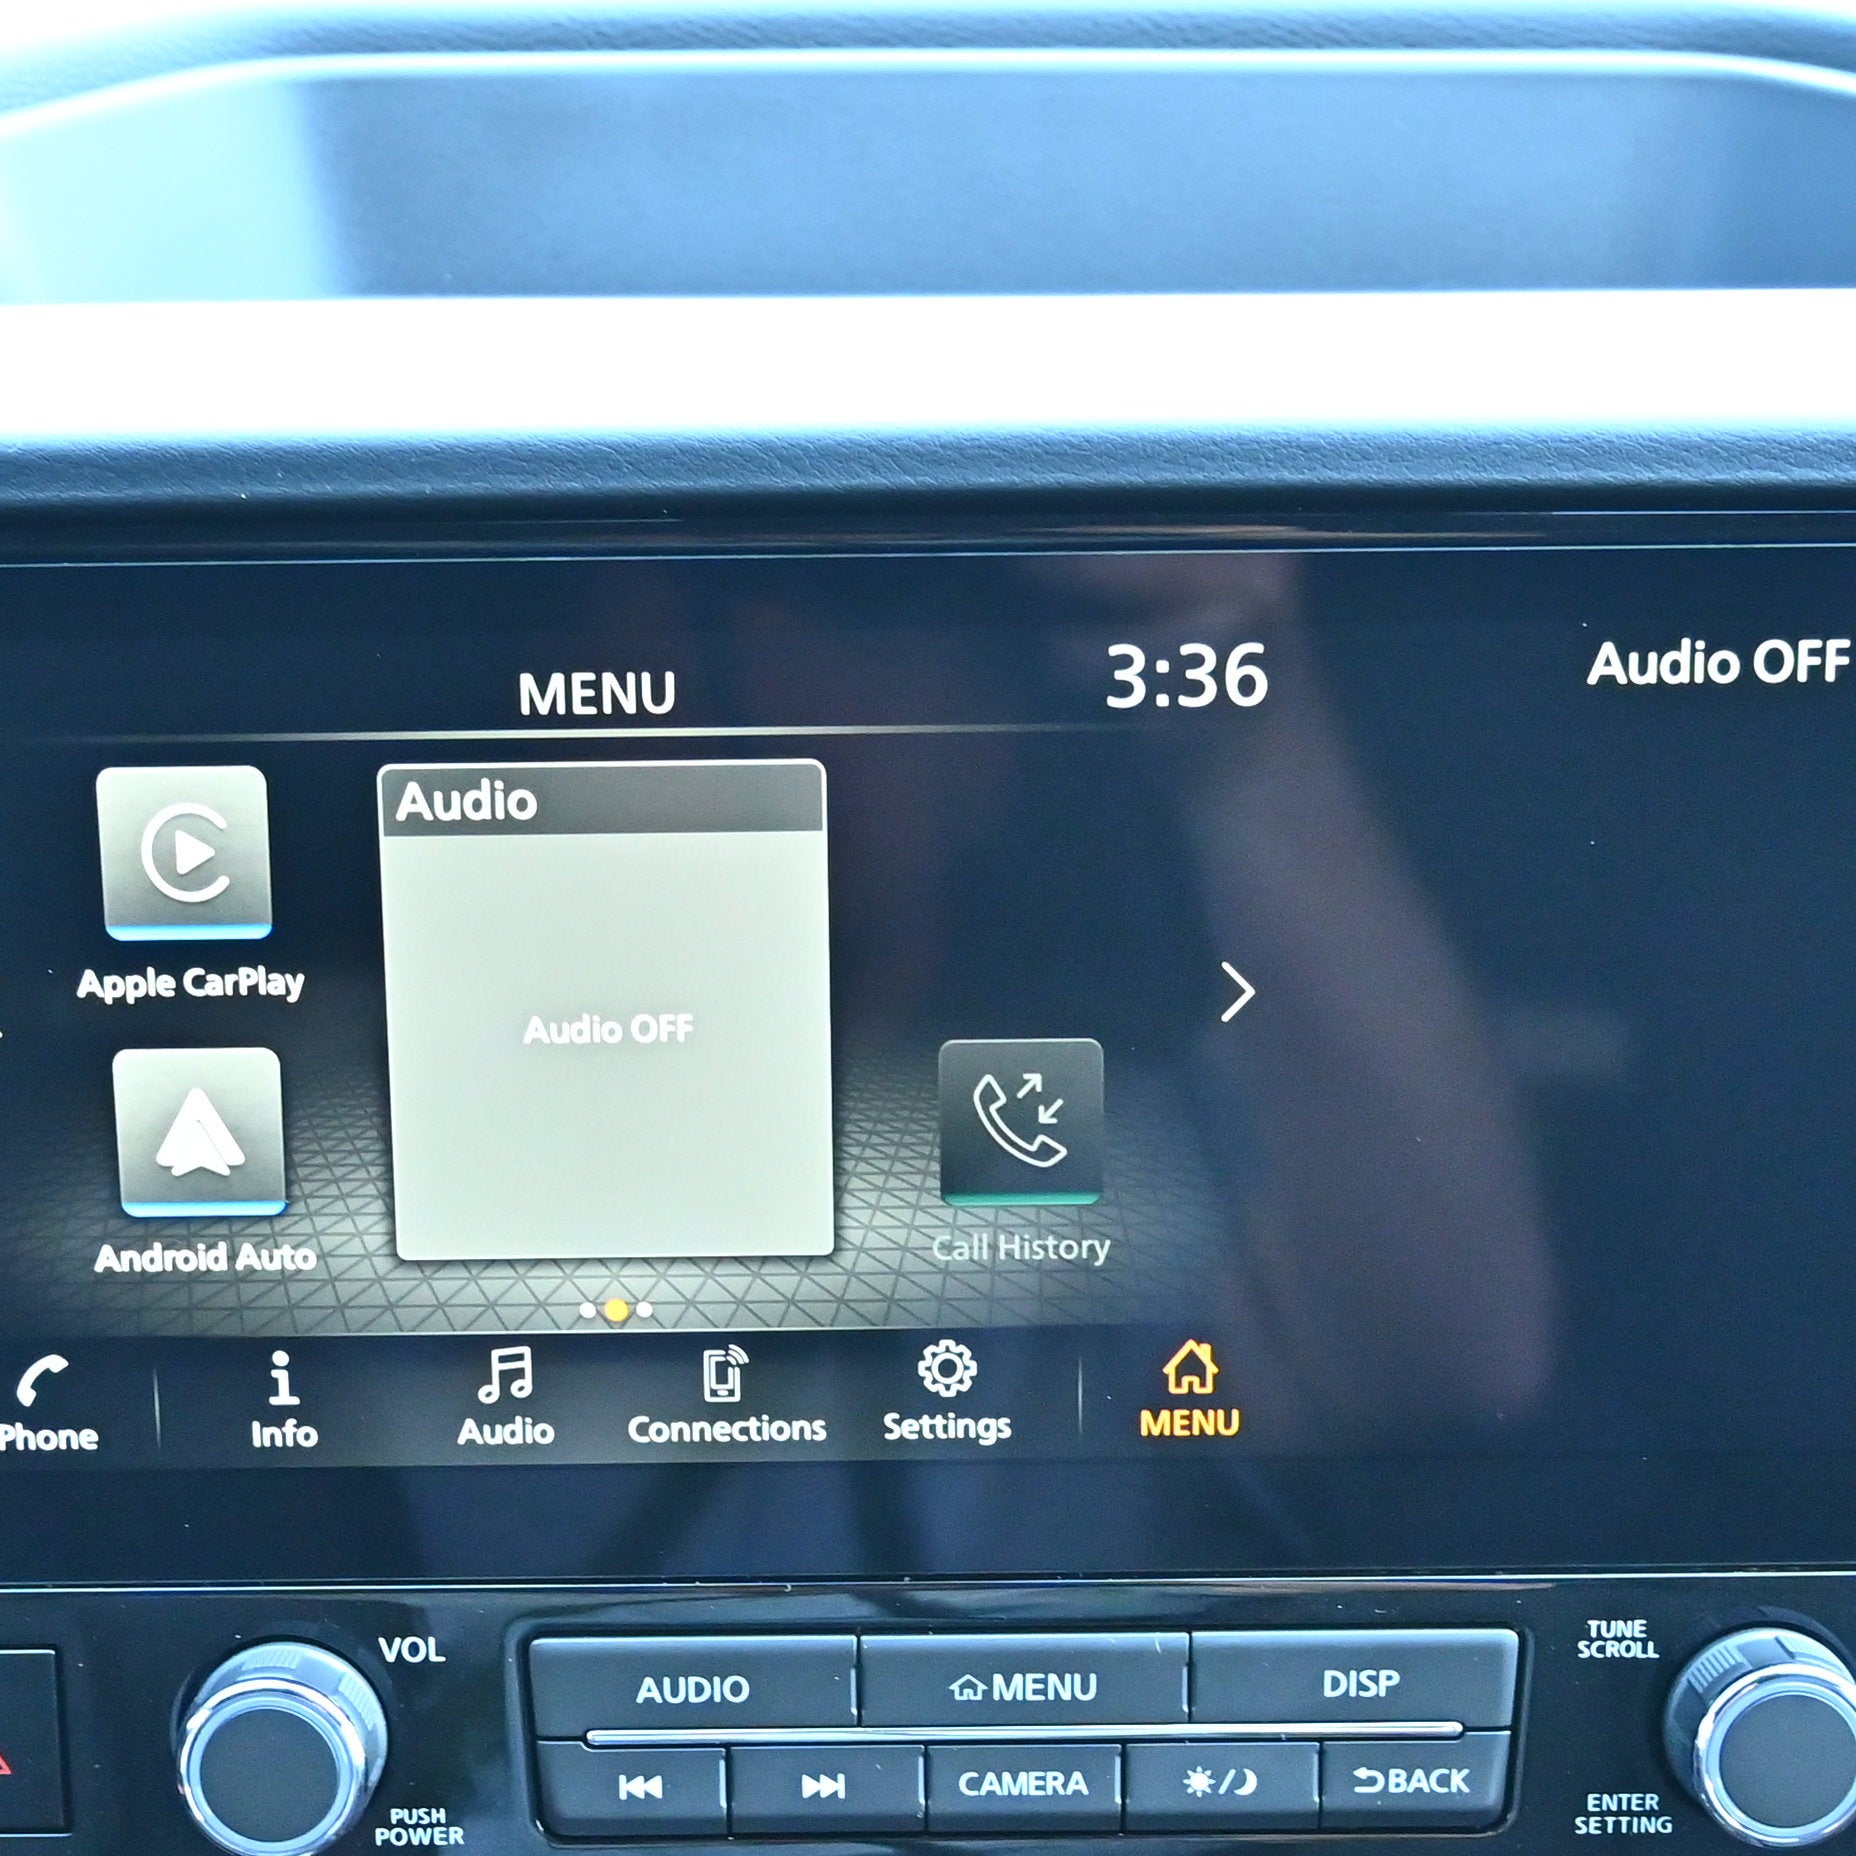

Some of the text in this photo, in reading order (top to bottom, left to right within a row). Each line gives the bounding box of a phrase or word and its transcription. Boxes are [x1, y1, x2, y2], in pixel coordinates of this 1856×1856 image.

[1105, 642, 1268, 709] 3:36
[1586, 638, 1852, 686] Audio OFF
[519, 672, 675, 716] MENU
[395, 778, 538, 824] Audio
[76, 966, 305, 1005] Apple CarPlay
[523, 1014, 694, 1046] Audio OFF
[94, 1242, 318, 1274] Android Auto
[932, 1230, 1112, 1268] Call History
[251, 1419, 319, 1450] Info
[457, 1416, 555, 1447] Audio
[627, 1412, 827, 1446] Connections
[883, 1411, 1012, 1447] Settings
[1140, 1408, 1241, 1438] MENU
[1588, 1620, 1647, 1640] TUNE
[378, 1636, 446, 1664] VOL
[1577, 1639, 1659, 1659] SCROLL
[635, 1674, 750, 1705] AUDIO
[992, 1671, 1098, 1703] MENU
[1322, 1667, 1401, 1699] DISP
[958, 1770, 1089, 1797] CAMERA
[1387, 1766, 1470, 1795] BACK
[389, 1807, 447, 1826] PUSH
[1586, 1792, 1659, 1812] ENTER
[374, 1826, 464, 1848] POWER
[1574, 1814, 1673, 1835] SETTING
